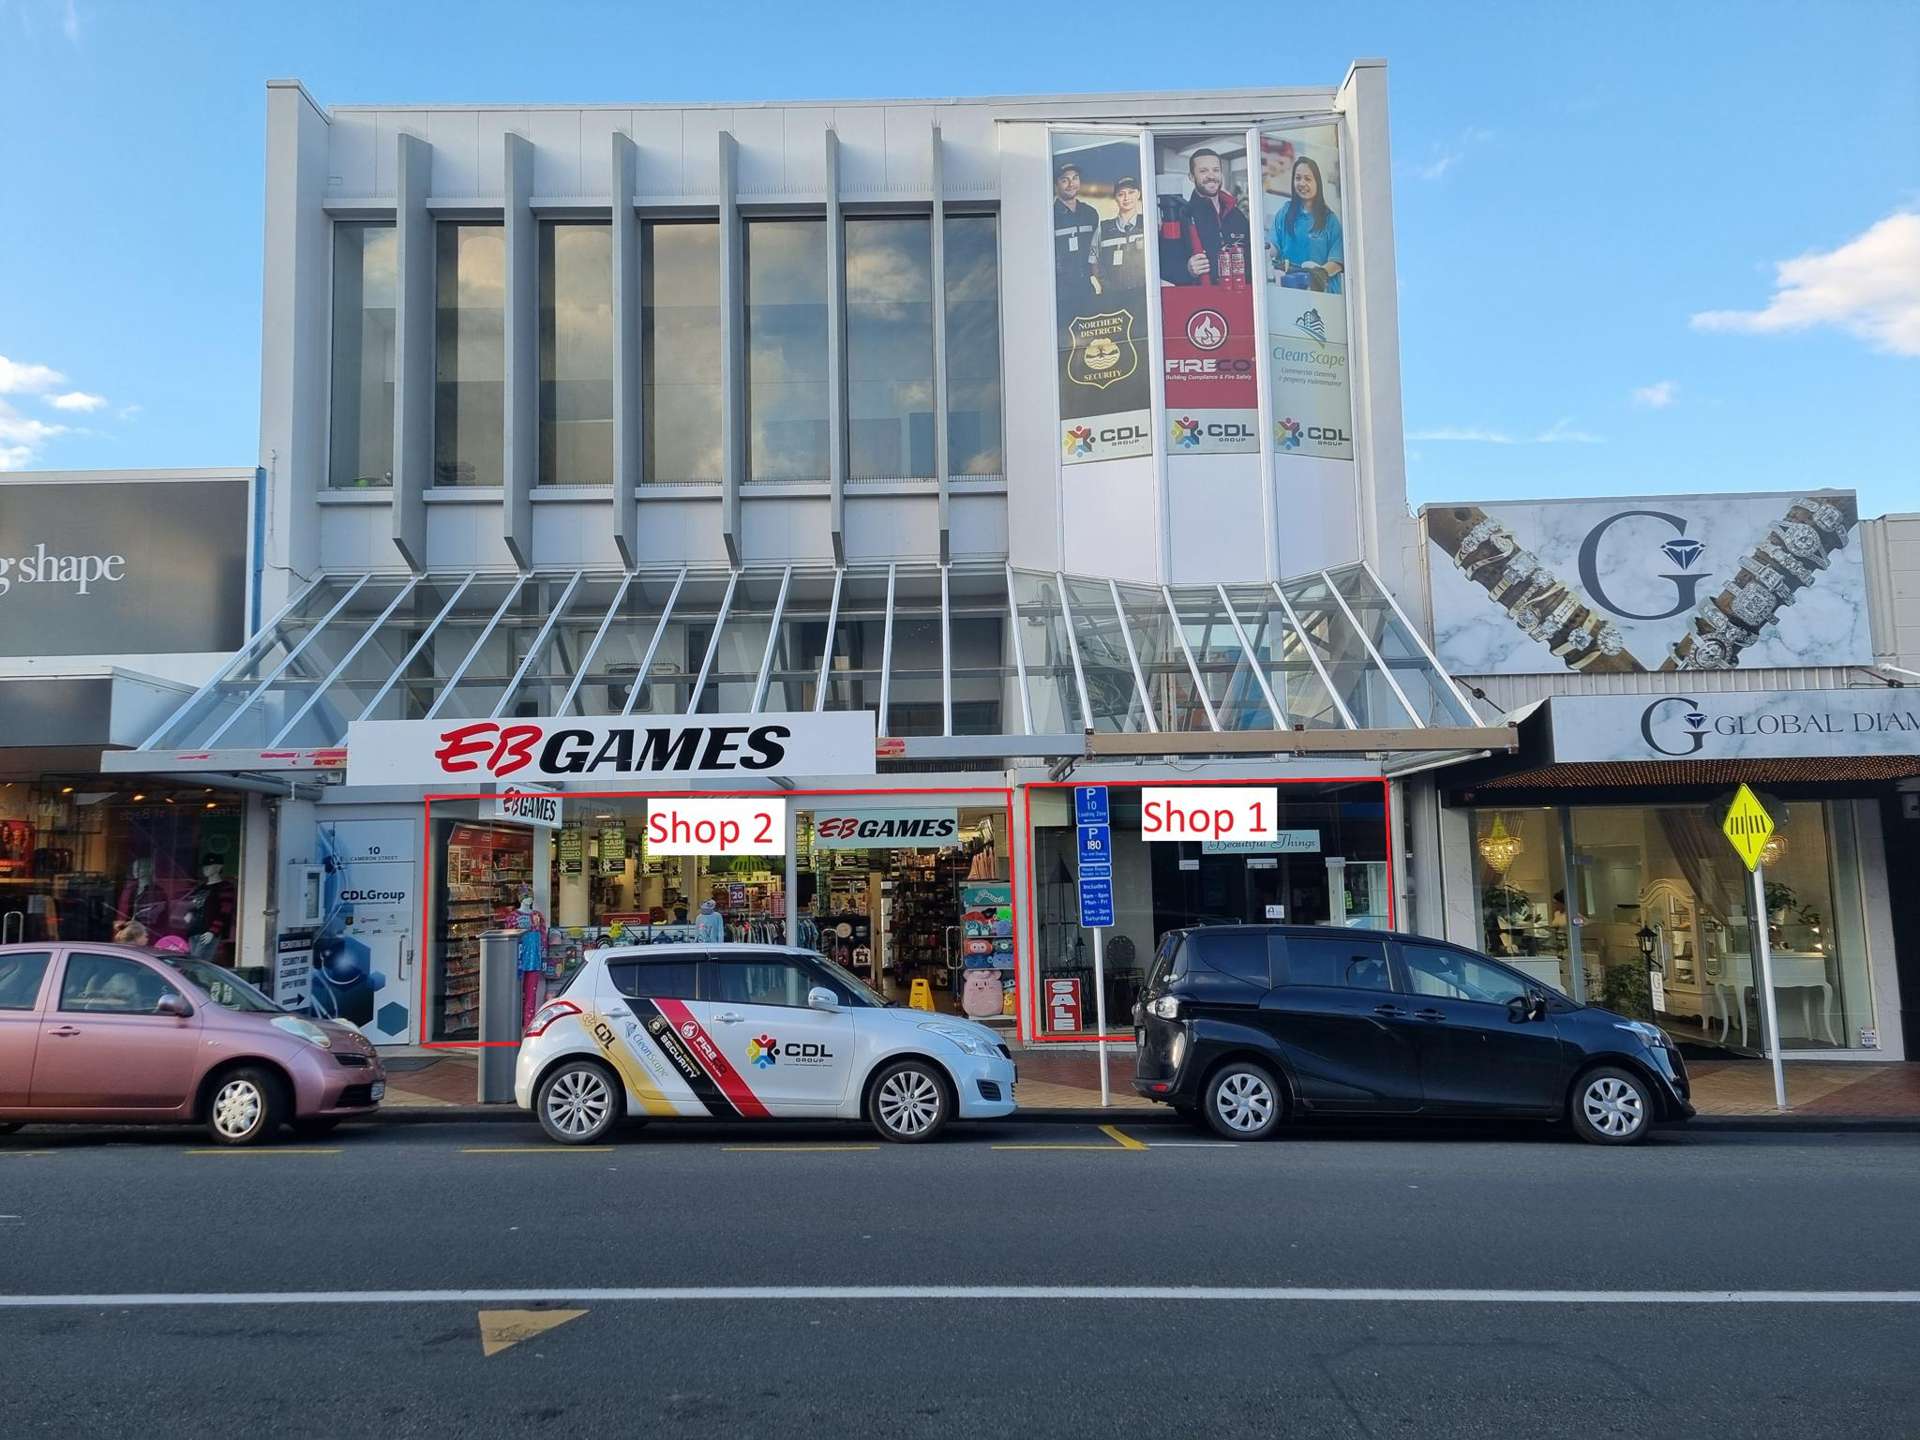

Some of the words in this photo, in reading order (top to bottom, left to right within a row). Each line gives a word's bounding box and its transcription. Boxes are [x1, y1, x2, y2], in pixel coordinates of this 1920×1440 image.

[1078, 316, 1124, 331] NORTHERN
[1081, 326, 1122, 338] DISTRICTS
[1273, 347, 1345, 368] CleanScape
[1165, 359, 1251, 373] FIRECO
[1084, 369, 1122, 381] SECURITY
[1188, 374, 1217, 382] Compliance
[1100, 425, 1148, 442] CDL
[1207, 424, 1255, 437] CDL
[1307, 427, 1350, 442] CDL
[1111, 440, 1140, 448] GROUP
[18, 543, 126, 595] shape
[1578, 511, 1712, 619] G
[1714, 713, 1844, 736] GLOBAL
[539, 725, 791, 774] GAMES
[1086, 788, 1096, 800] P
[520, 797, 557, 822] GAMES
[1087, 801, 1097, 810] 10
[857, 818, 955, 838] GAMES
[1088, 828, 1098, 840] P
[1087, 840, 1102, 850] 180
[1270, 832, 1317, 851] Things
[368, 846, 381, 855] 10
[1050, 981, 1077, 1031] SALE
[594, 1023, 616, 1050] CDL
[633, 1034, 669, 1077] CleanScape
[660, 1034, 697, 1078] SECURITY
[785, 1043, 833, 1058] CDL
